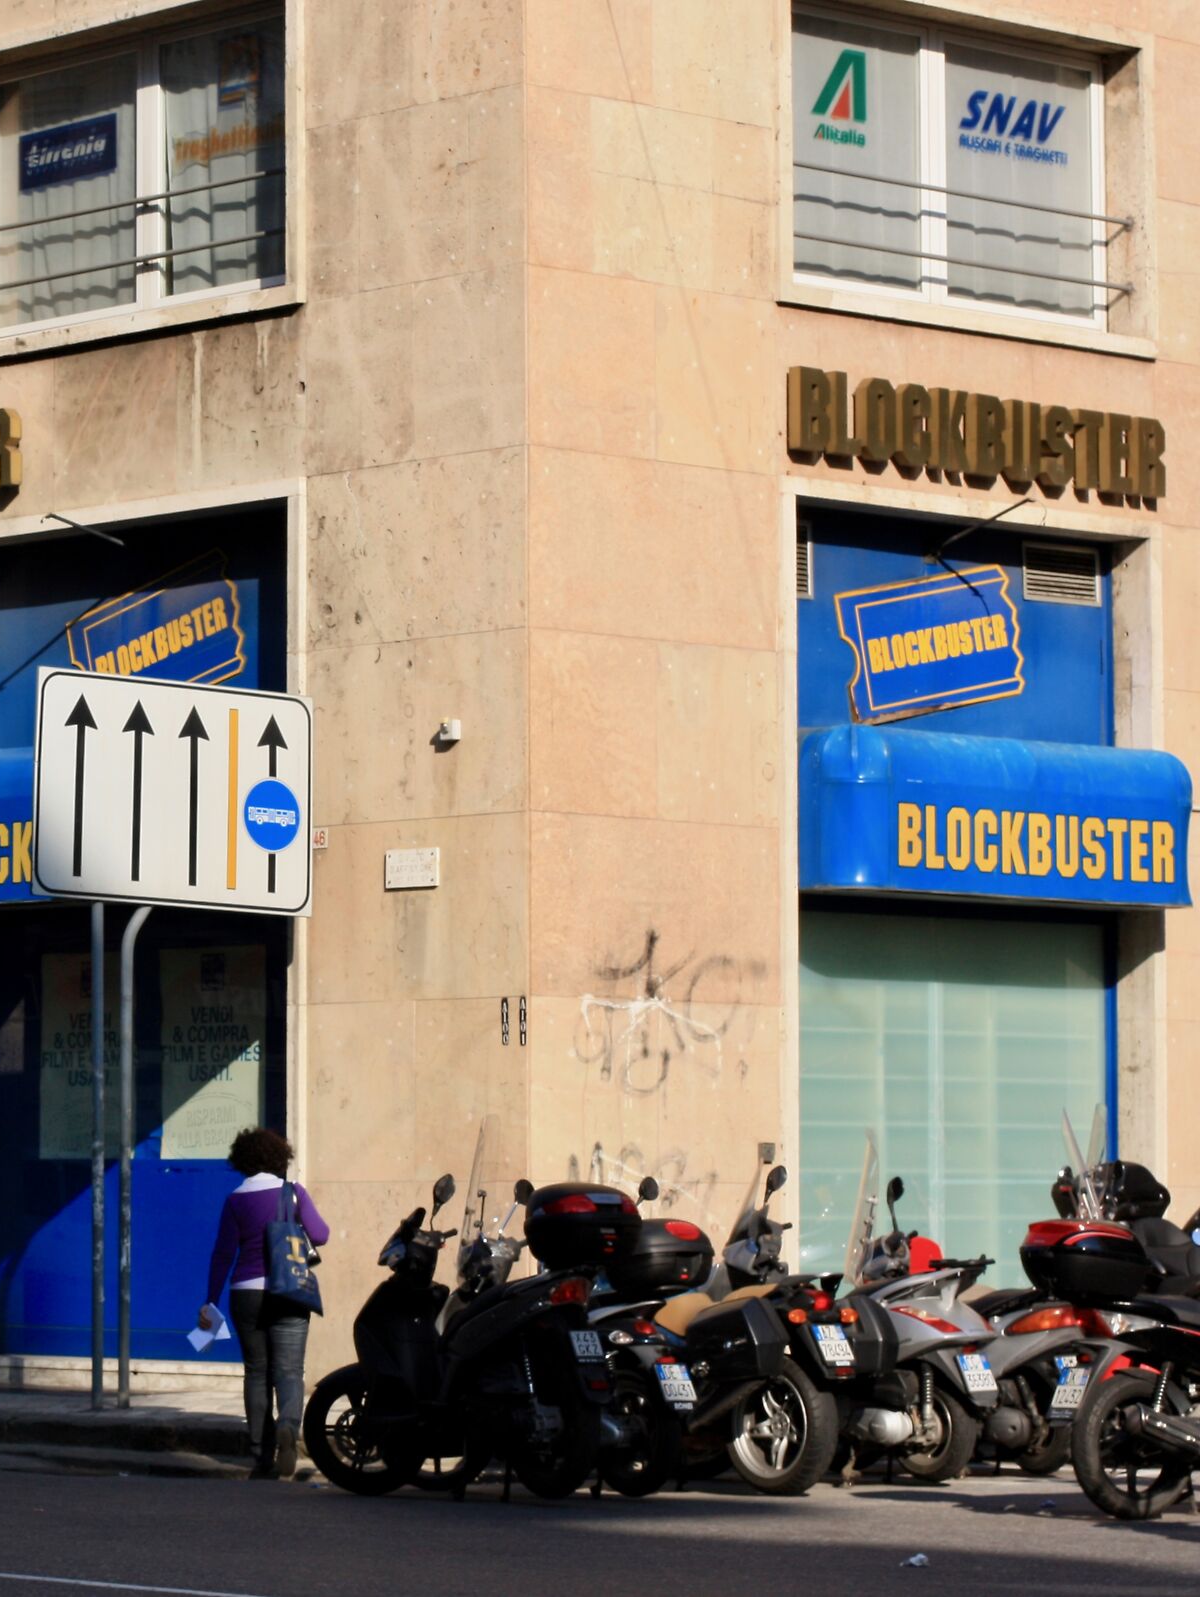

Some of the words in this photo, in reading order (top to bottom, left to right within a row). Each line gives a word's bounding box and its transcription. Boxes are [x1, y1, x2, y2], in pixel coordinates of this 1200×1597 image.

[959, 89, 1066, 145] SNAV
[813, 122, 866, 148] Alitalia
[787, 366, 1167, 497] BLOCKBUSTER
[95, 597, 229, 677] BLOCKBUSTER
[867, 613, 1009, 674] BLOCKBUSTER
[898, 802, 1175, 884] BLOCKBUSTER
[191, 1005, 233, 1024] VENDI
[54, 1032, 64, 1049] &
[173, 1025, 184, 1043] &
[187, 1024, 249, 1042] COMPRA
[42, 1051, 74, 1069] FILM
[78, 1050, 86, 1068] E
[160, 1045, 194, 1063] FILM
[199, 1045, 207, 1061] E
[210, 1042, 262, 1062] GAMES
[190, 1064, 233, 1082] USATI.
